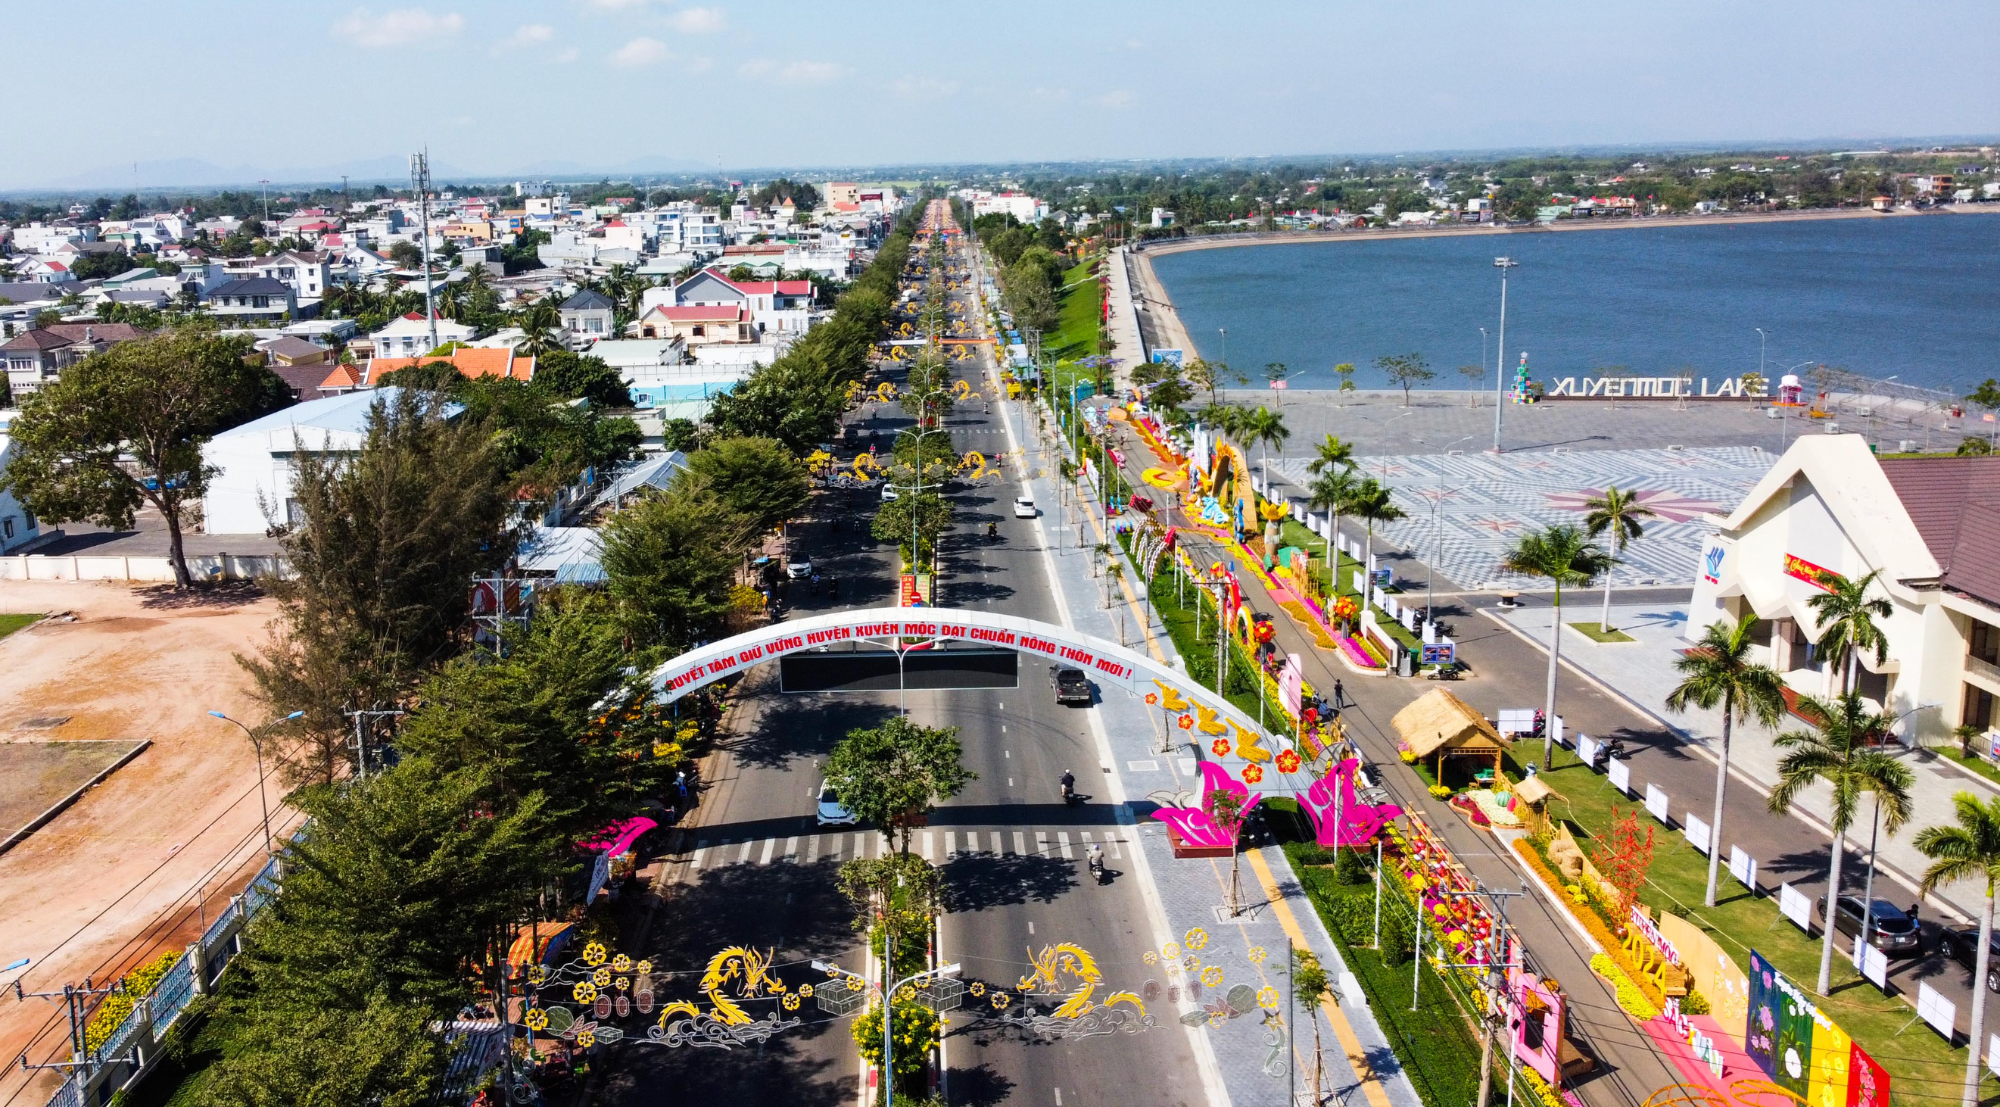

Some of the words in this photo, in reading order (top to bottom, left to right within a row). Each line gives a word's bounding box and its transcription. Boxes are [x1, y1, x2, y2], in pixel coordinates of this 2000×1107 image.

[1700, 377, 1770, 397] LAKE
[665, 666, 705, 690] QUYẾT
[707, 655, 737, 674] TÂM
[739, 645, 763, 662] GIỮ
[766, 636, 803, 655] VỮNG
[807, 625, 851, 642] HUYỆN
[855, 621, 899, 637] XUYÊN
[904, 621, 937, 638] MỘC
[941, 625, 967, 640] ĐẠT
[970, 627, 1016, 645] CHUẨN
[1019, 636, 1056, 655] NÔNG
[1060, 645, 1094, 666] THÔN
[1096, 657, 1124, 678] MỚI
[1622, 922, 1667, 999] 2024
